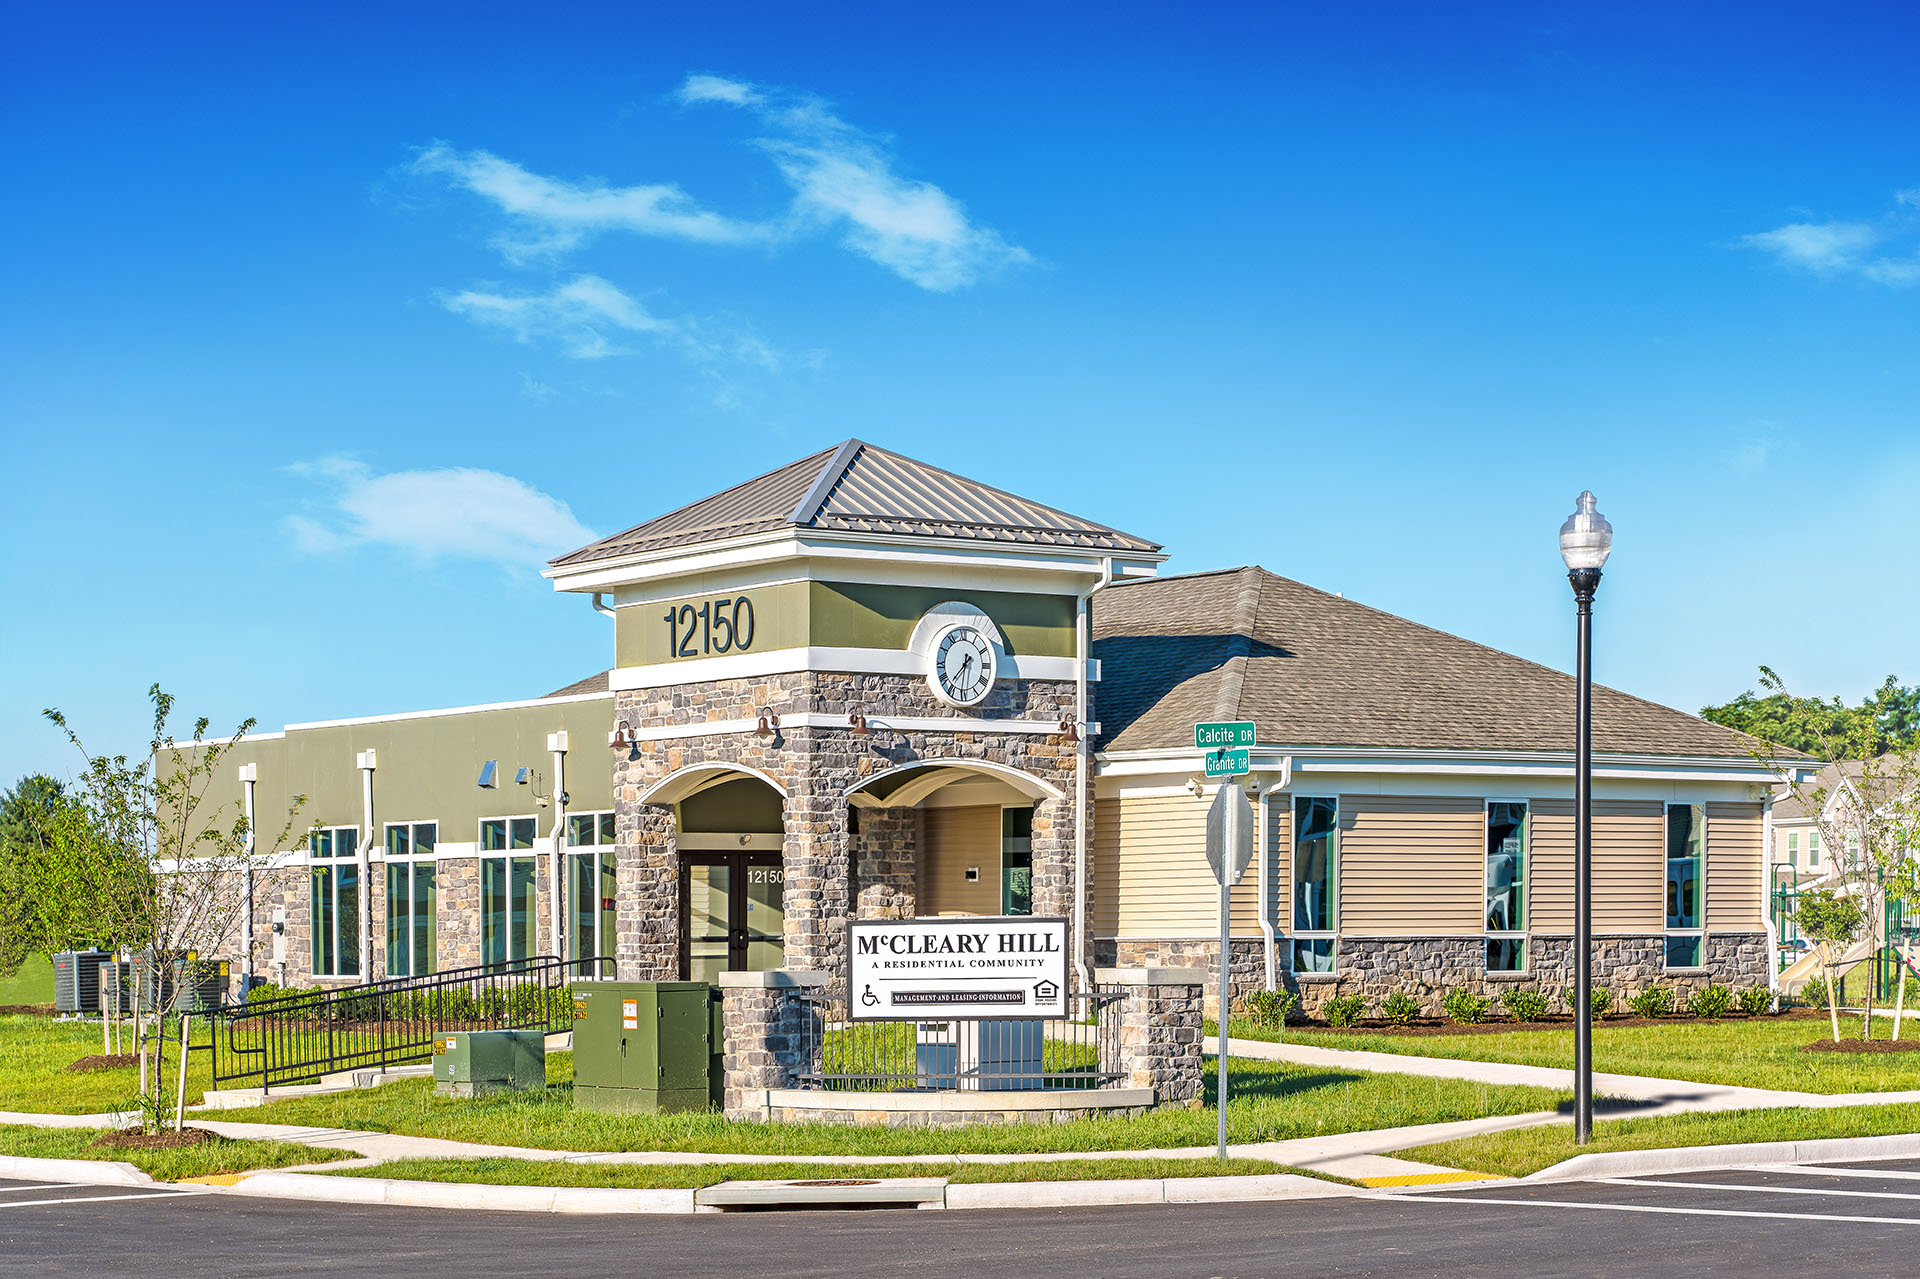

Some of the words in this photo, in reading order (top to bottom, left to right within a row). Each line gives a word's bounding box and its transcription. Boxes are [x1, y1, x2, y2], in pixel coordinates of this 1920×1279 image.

[663, 596, 754, 658] 12150
[1198, 728, 1234, 743] Calcite
[1241, 730, 1252, 741] DR
[1207, 756, 1235, 771] Granite
[1238, 758, 1247, 769] DR
[748, 870, 783, 883] 12150
[857, 934, 989, 954] McCLEARY
[997, 933, 1059, 953] HILL
[884, 960, 964, 968] RESIDENTIAL
[969, 959, 1044, 967] COMMUNITY
[952, 993, 978, 1001] LEASING
[979, 993, 1020, 1001] INFORMATION
